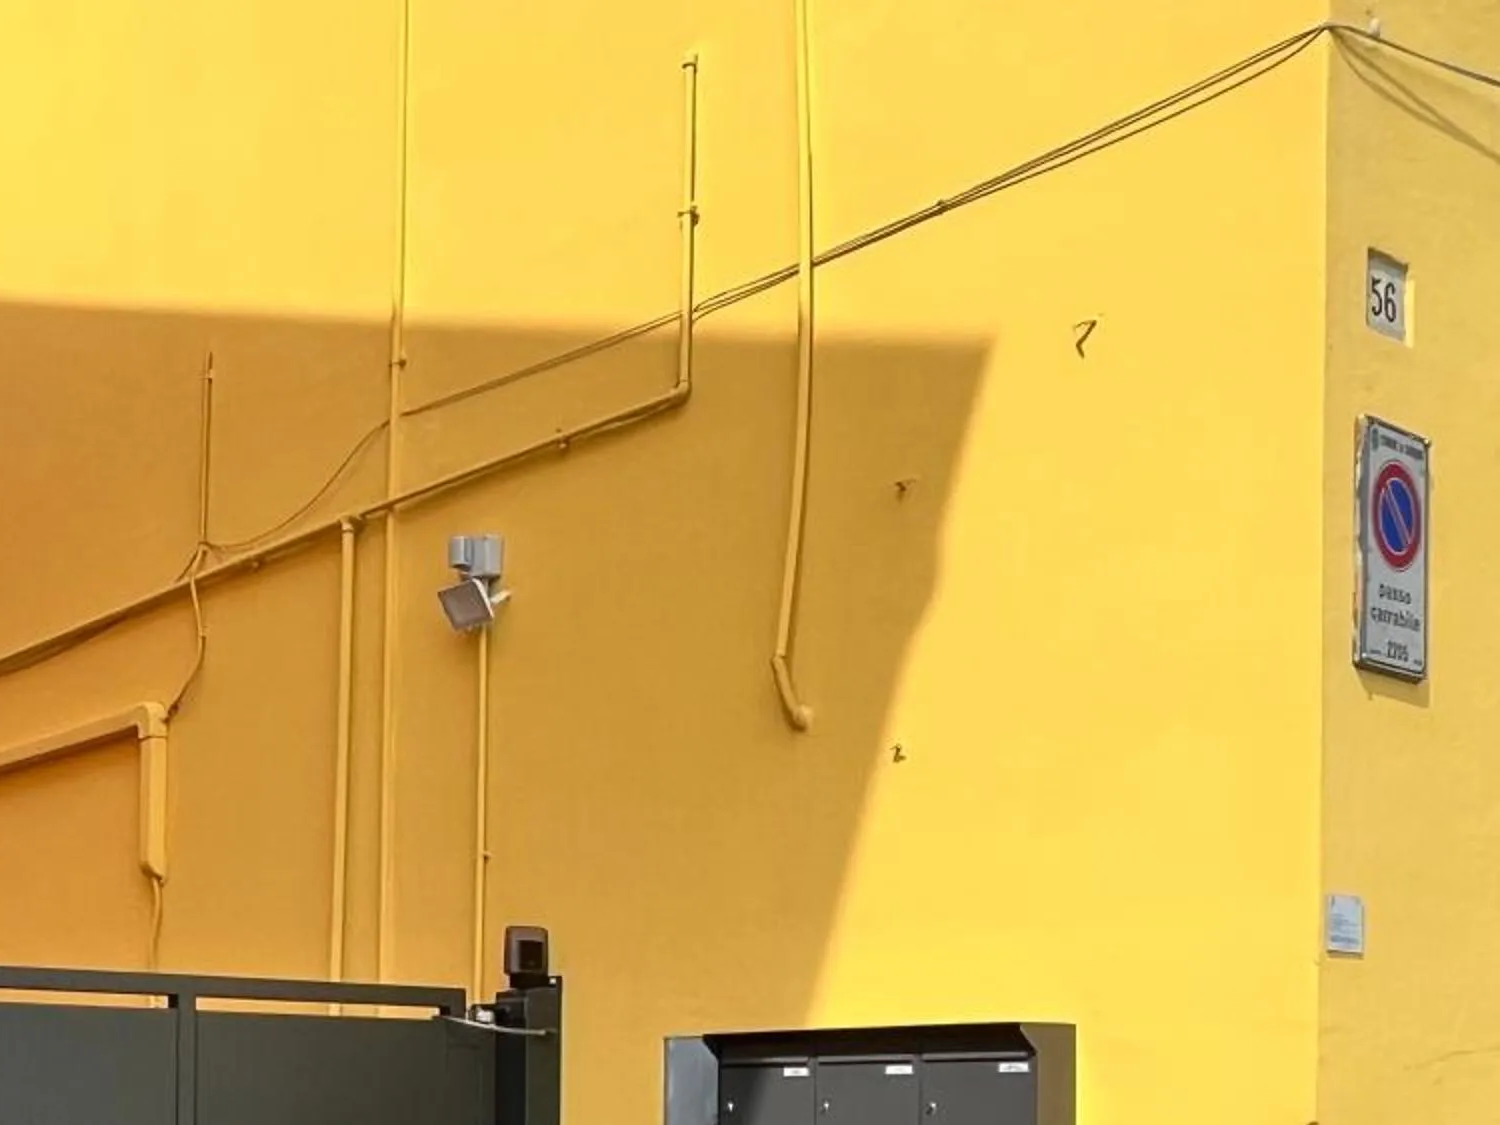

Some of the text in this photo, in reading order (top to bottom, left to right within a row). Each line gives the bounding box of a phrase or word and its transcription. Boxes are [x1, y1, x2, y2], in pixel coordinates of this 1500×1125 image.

[1371, 276, 1397, 323] 56
[1379, 583, 1412, 605] passo
[1371, 607, 1421, 632] carrabile
